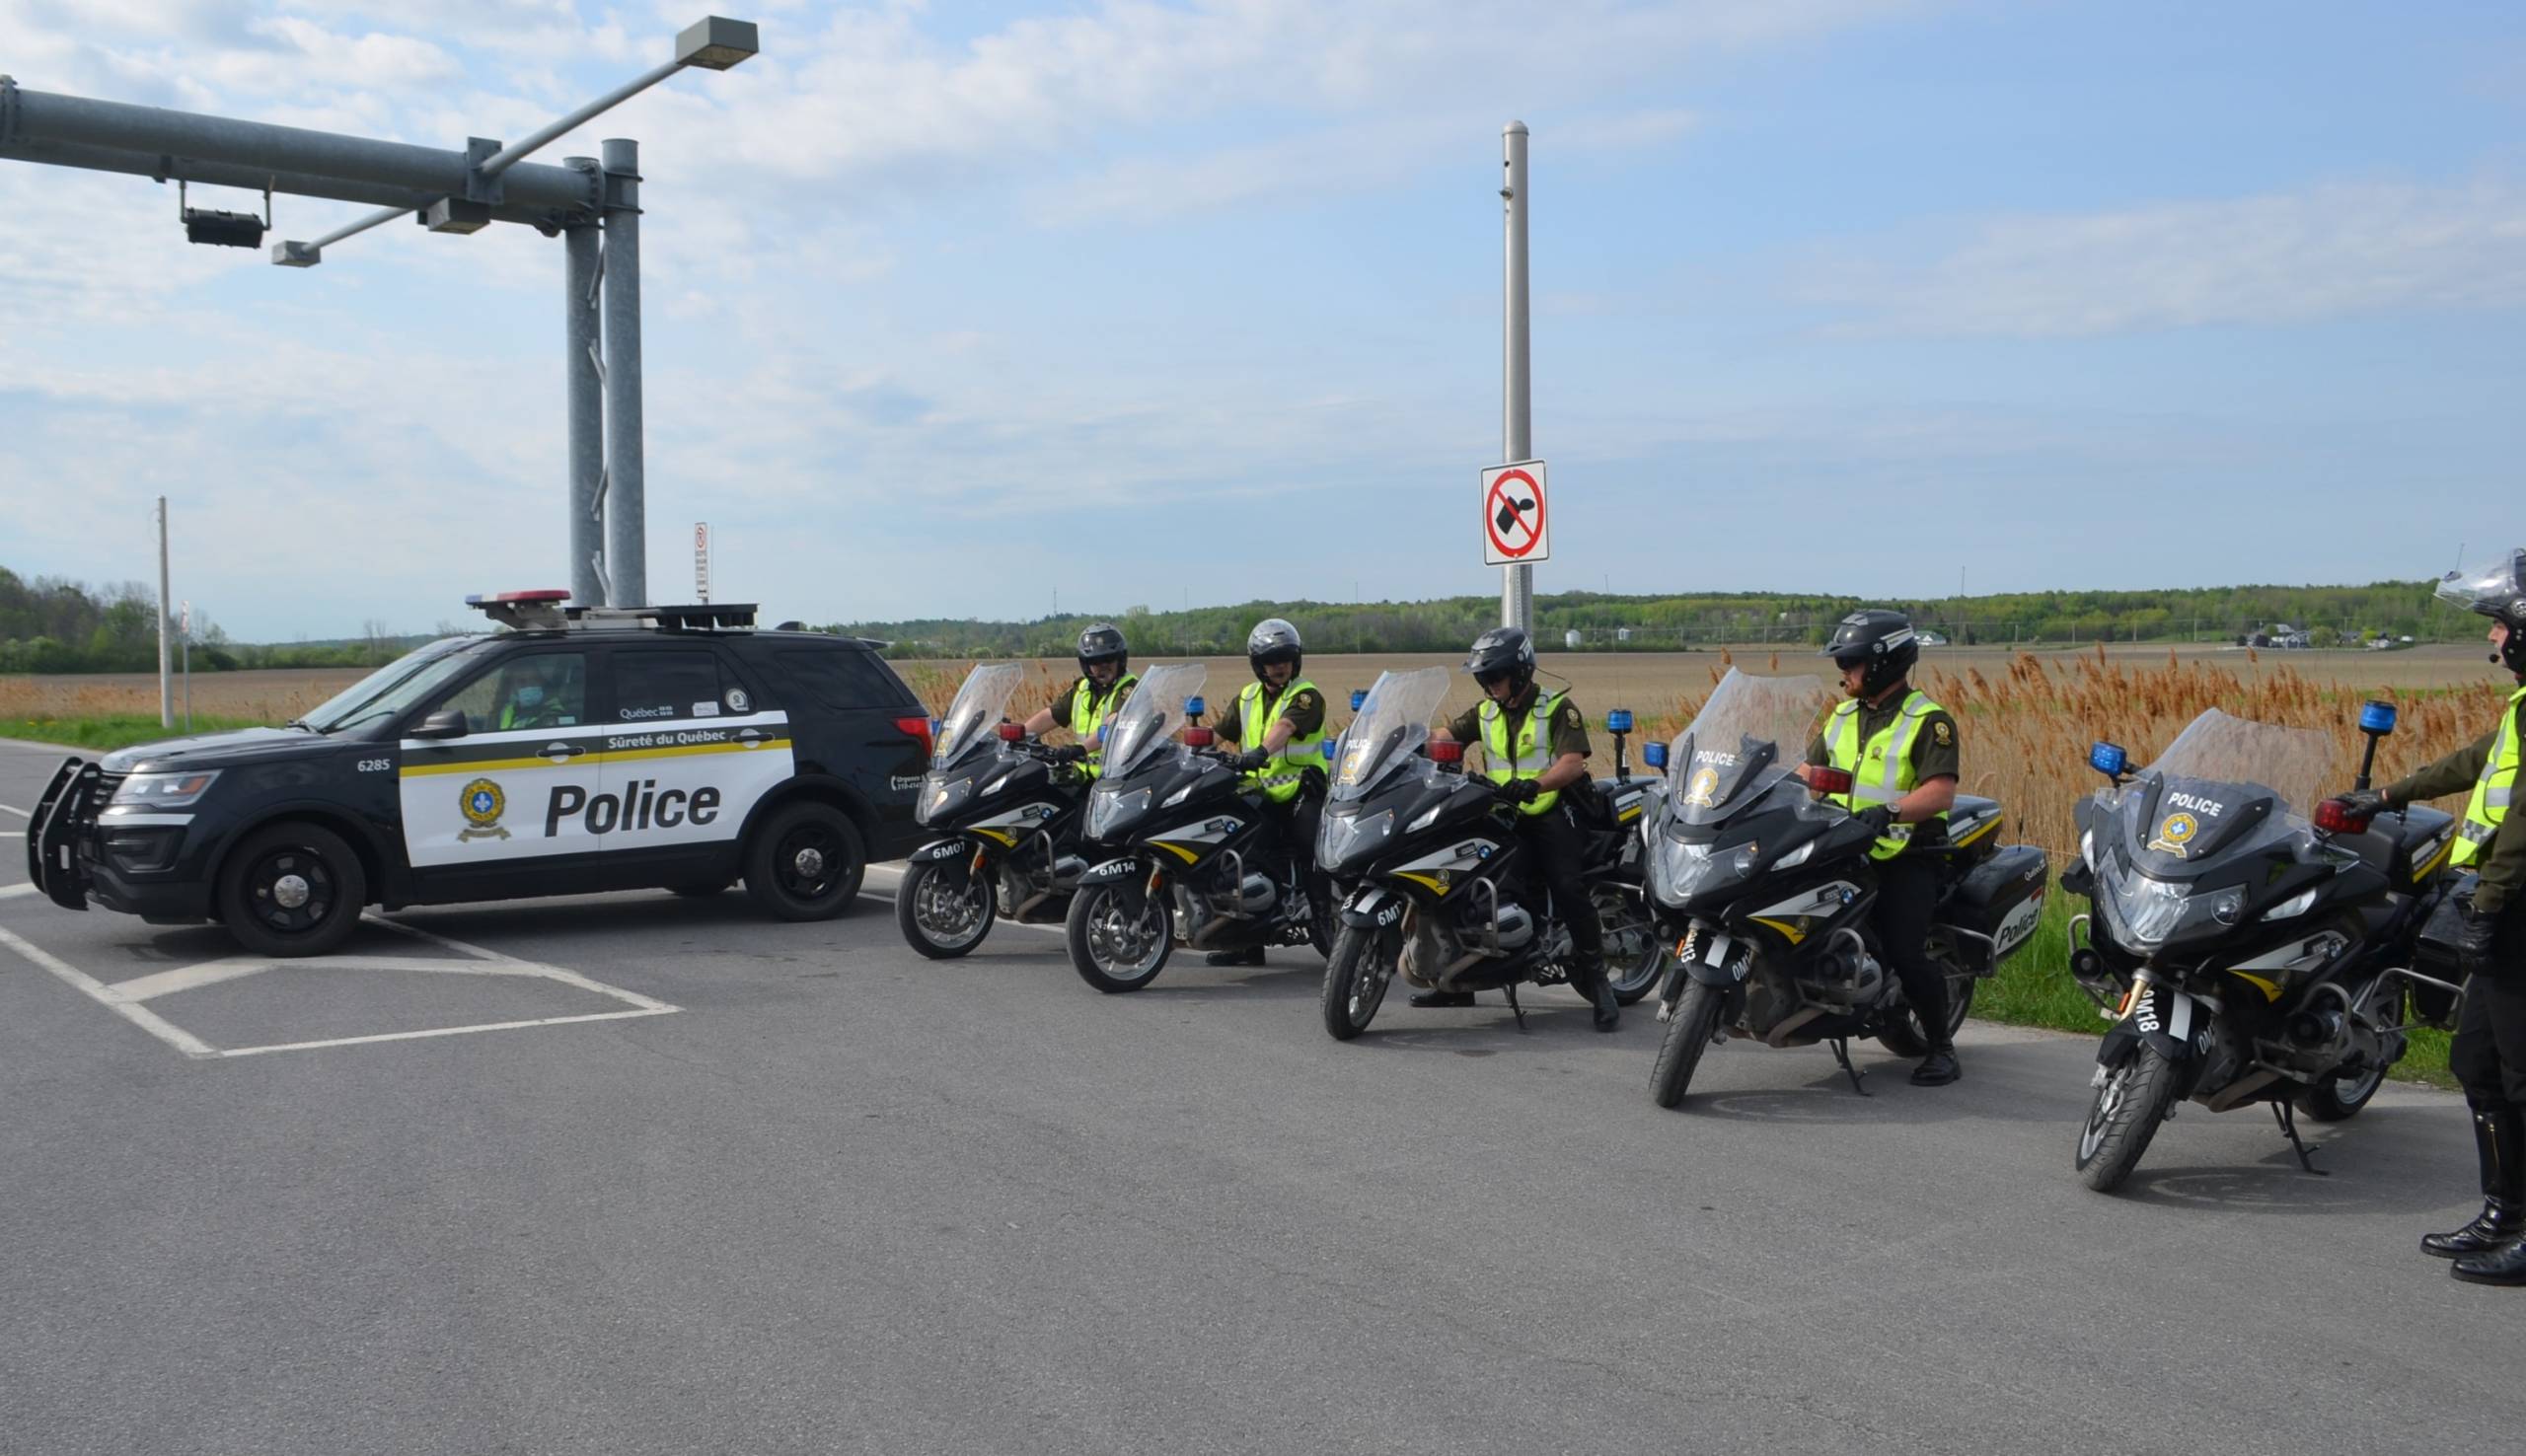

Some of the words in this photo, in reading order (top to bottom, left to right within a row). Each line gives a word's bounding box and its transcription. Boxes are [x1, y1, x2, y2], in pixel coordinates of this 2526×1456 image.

[620, 708, 659, 720] Québec
[608, 735, 653, 750] Sûreté
[656, 734, 674, 745] du
[677, 731, 726, 744] Québec
[357, 759, 391, 772] 6285
[1695, 750, 1736, 766] POLICE
[545, 779, 720, 837] Police
[2168, 792, 2223, 817] POLICE
[1099, 861, 1136, 876] 6M14
[1998, 908, 2039, 949] Police
